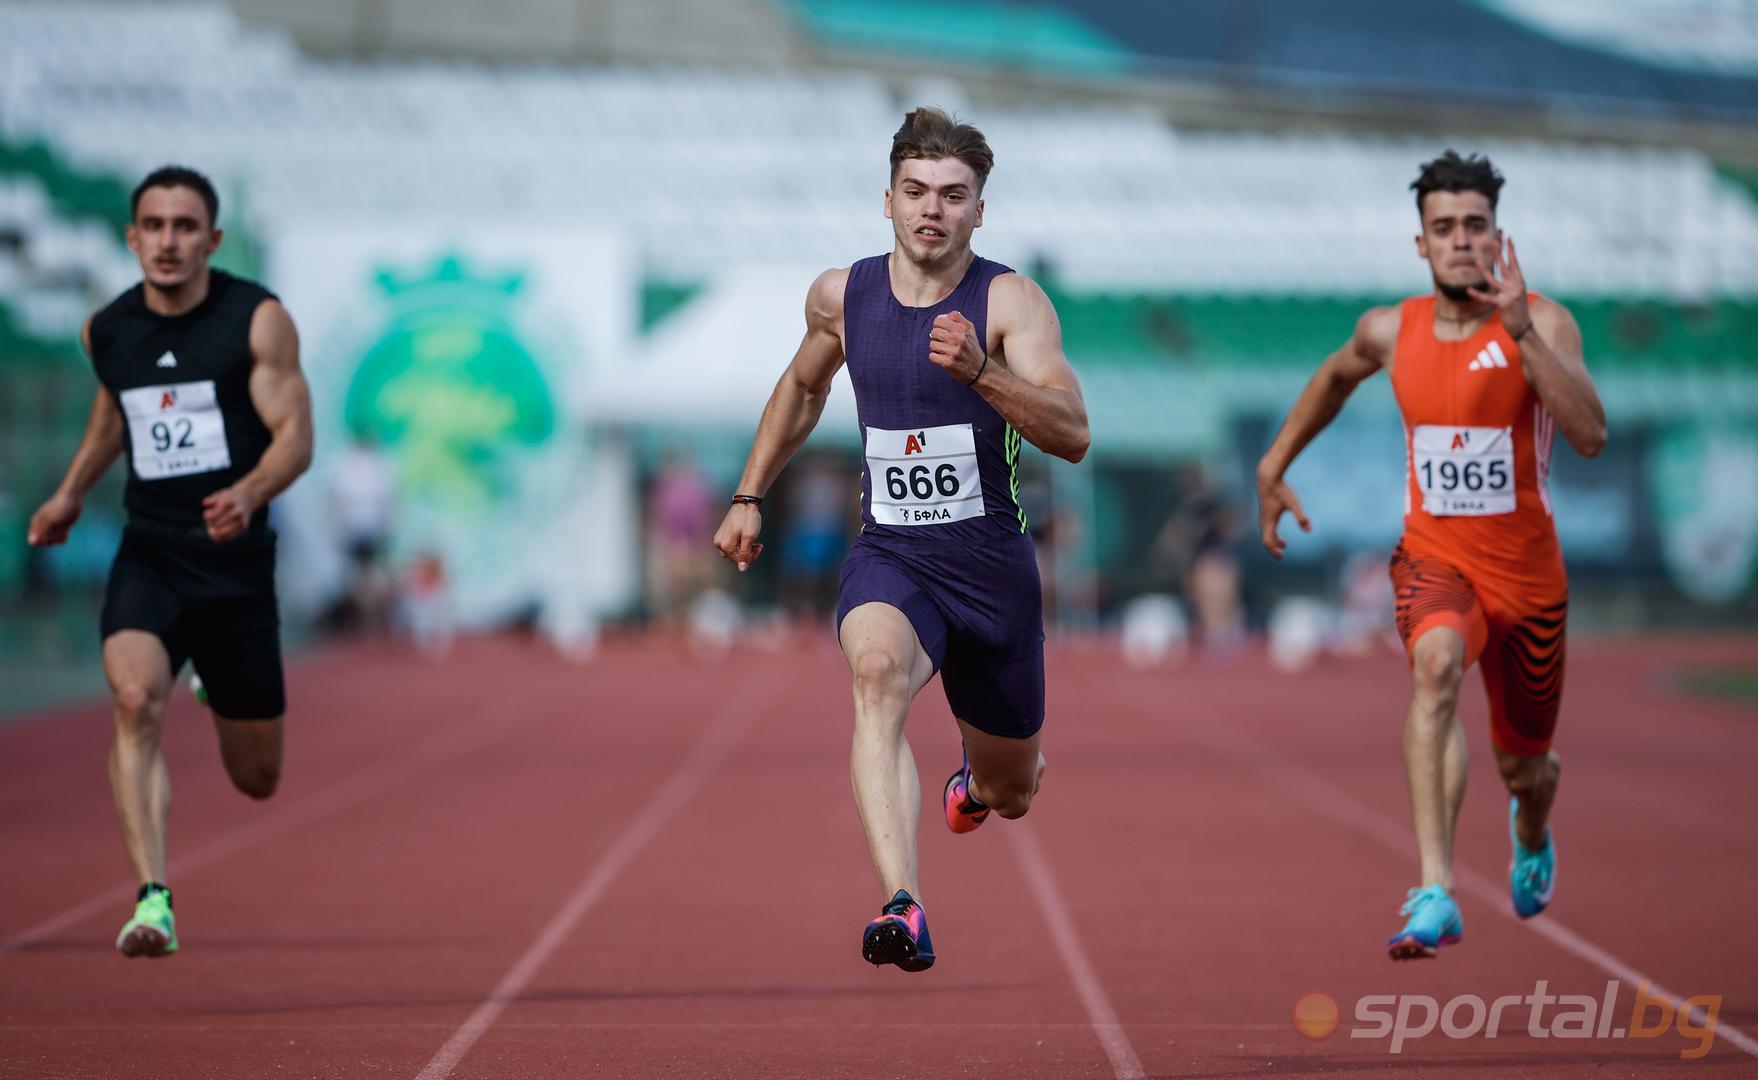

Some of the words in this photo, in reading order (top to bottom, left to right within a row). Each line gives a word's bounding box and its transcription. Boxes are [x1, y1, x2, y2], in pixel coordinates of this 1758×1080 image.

[151, 418, 195, 452] 92
[905, 431, 926, 455] A1
[885, 463, 960, 501] 666
[1421, 460, 1508, 491] 1965
[914, 508, 951, 521] БФЛА
